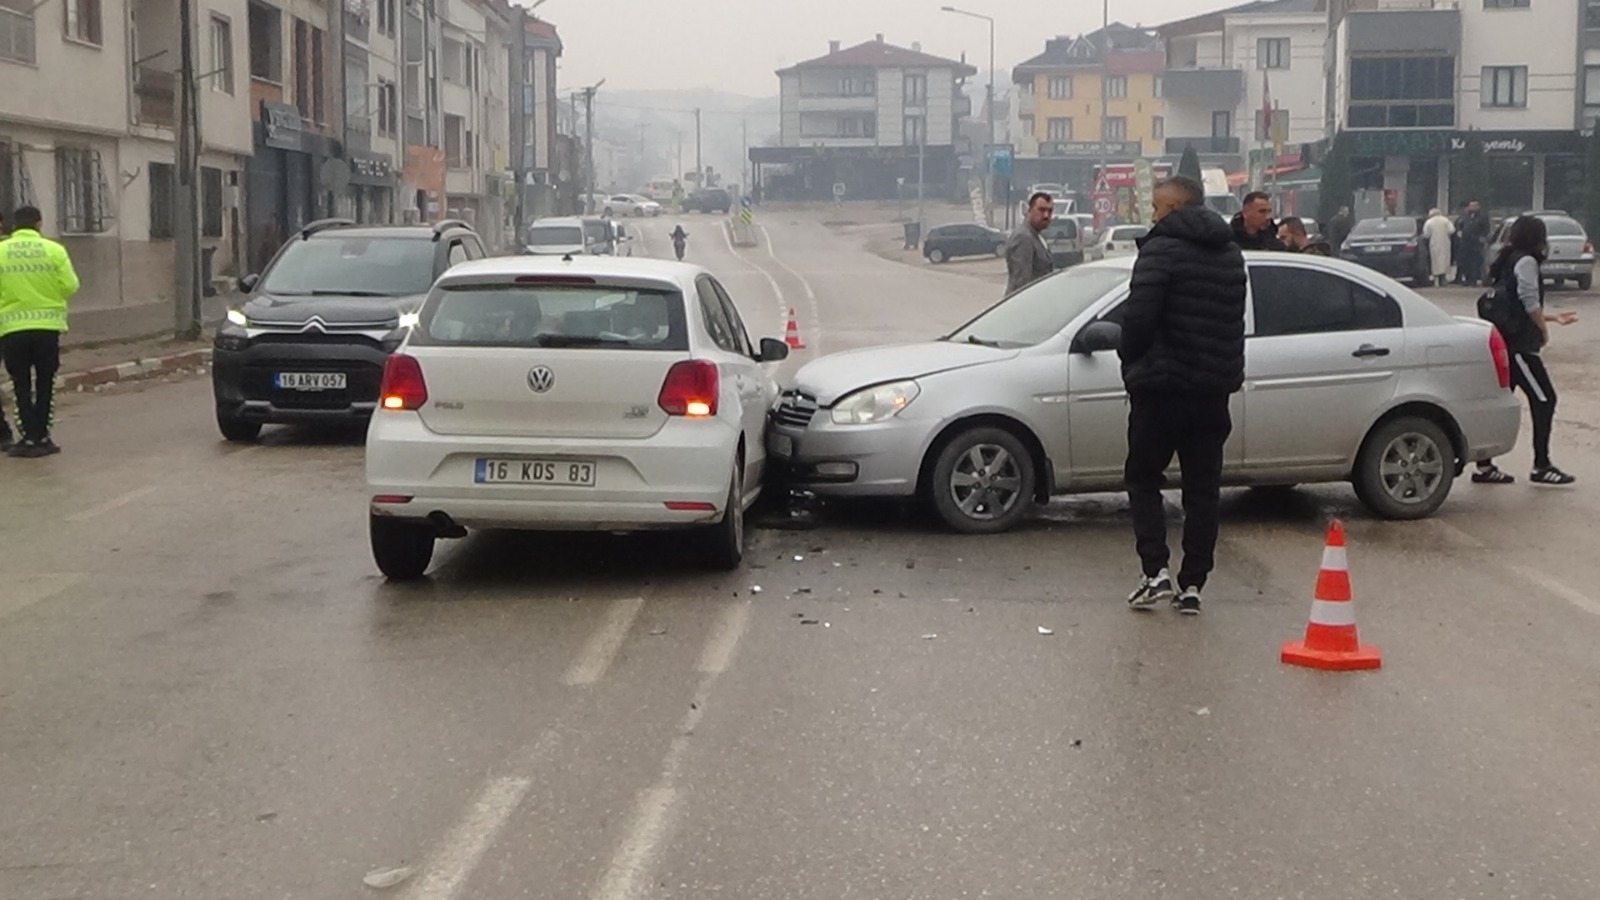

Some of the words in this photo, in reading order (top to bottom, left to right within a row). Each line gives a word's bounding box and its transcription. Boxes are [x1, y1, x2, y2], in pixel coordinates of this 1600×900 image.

[282, 374, 296, 386] 16
[298, 374, 320, 386] ARV
[322, 374, 345, 386] 057
[488, 462, 508, 480] 16
[569, 464, 590, 482] 83
